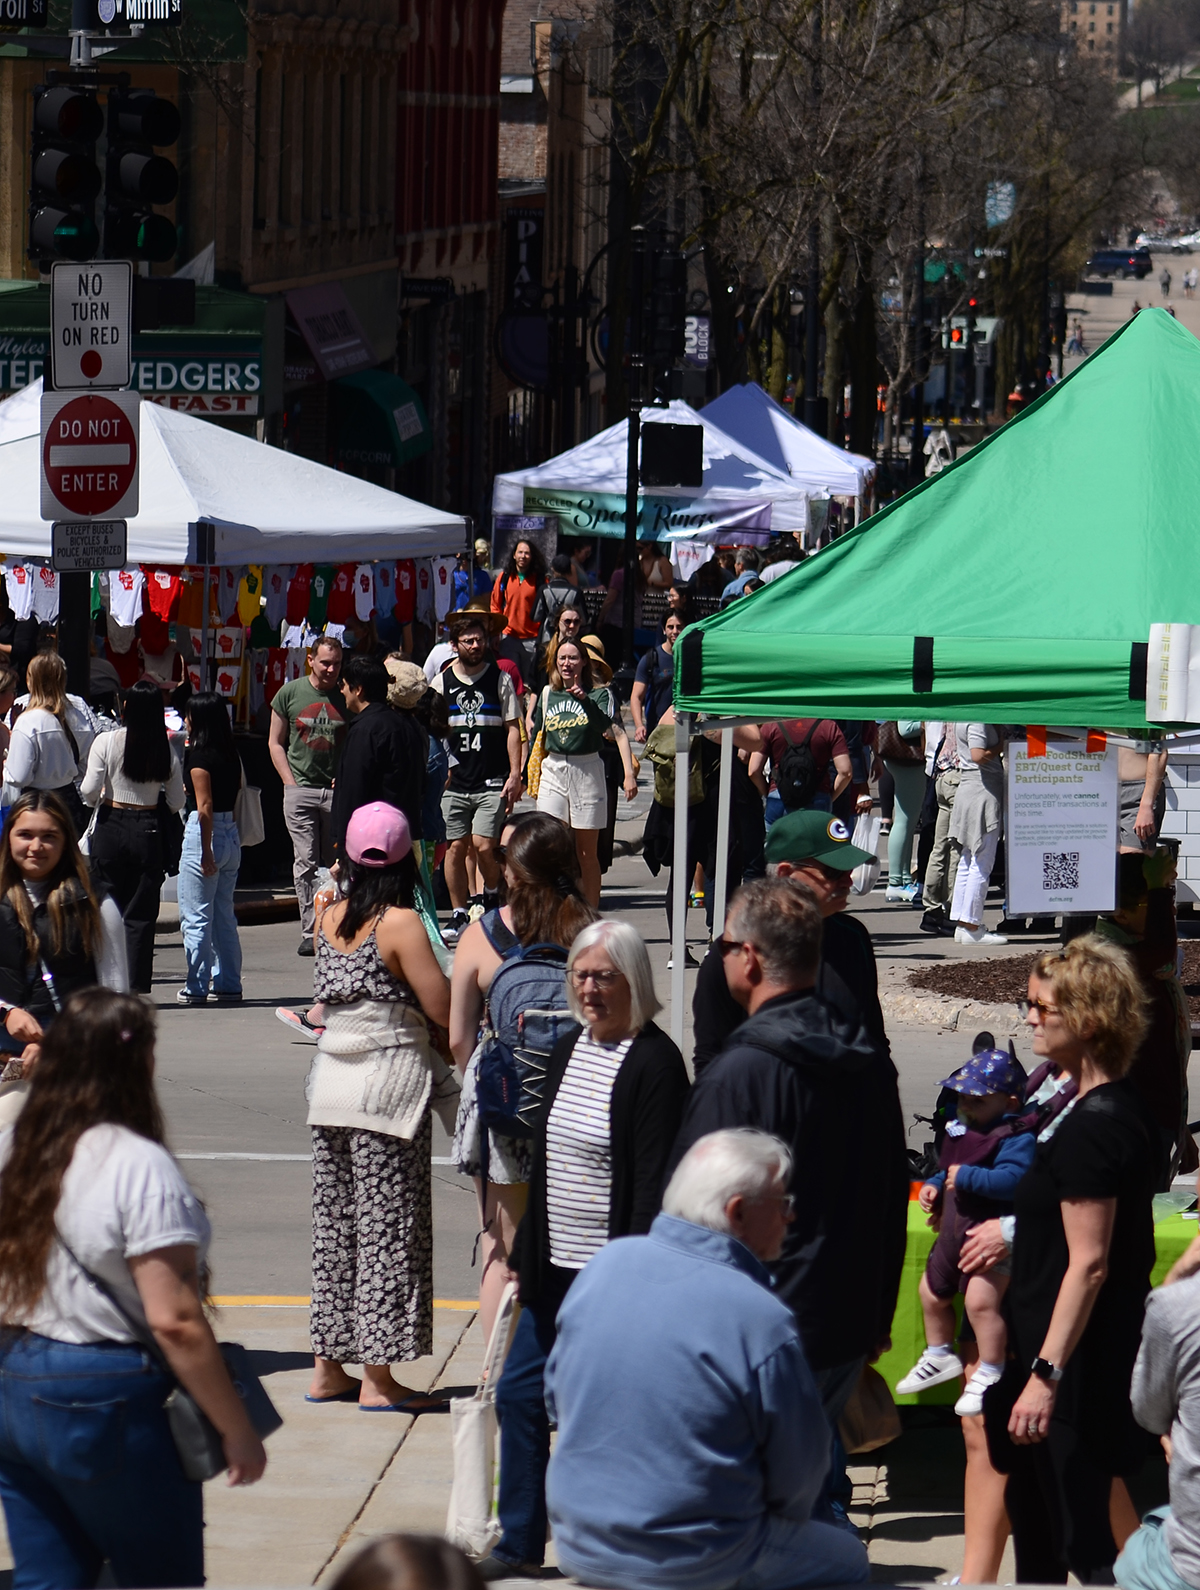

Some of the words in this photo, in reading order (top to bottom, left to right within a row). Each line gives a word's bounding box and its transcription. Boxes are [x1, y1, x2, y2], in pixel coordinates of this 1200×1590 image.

[32, 0, 43, 13] St
[172, 0, 181, 12] St
[78, 273, 102, 296] NO
[405, 284, 447, 293] TAVERN
[71, 302, 110, 321] TURN
[62, 327, 83, 347] ON
[90, 326, 120, 346] RED
[698, 325, 708, 359] BLOCK
[60, 420, 84, 438] DO
[88, 419, 121, 437] NOT
[339, 450, 391, 464] POPCORN
[61, 473, 118, 492] ENTER
[525, 497, 573, 507] RECYCLED
[653, 503, 716, 539] Rings
[66, 526, 90, 536] EXCEPT
[92, 524, 114, 534] BUSES
[70, 536, 100, 546] BICYCLES
[104, 535, 109, 545] &
[57, 547, 80, 557] POLICE
[82, 545, 122, 556] AUTHORIZED
[74, 557, 105, 567] VEHICLES
[545, 713, 589, 732] Bucks
[460, 733, 481, 752] 34
[1046, 751, 1109, 761] FoodShare/
[1015, 762, 1071, 773] EBT/Quest
[1075, 762, 1101, 771] Card
[1015, 774, 1083, 785] Participants
[1015, 793, 1060, 801] Unfortunately,
